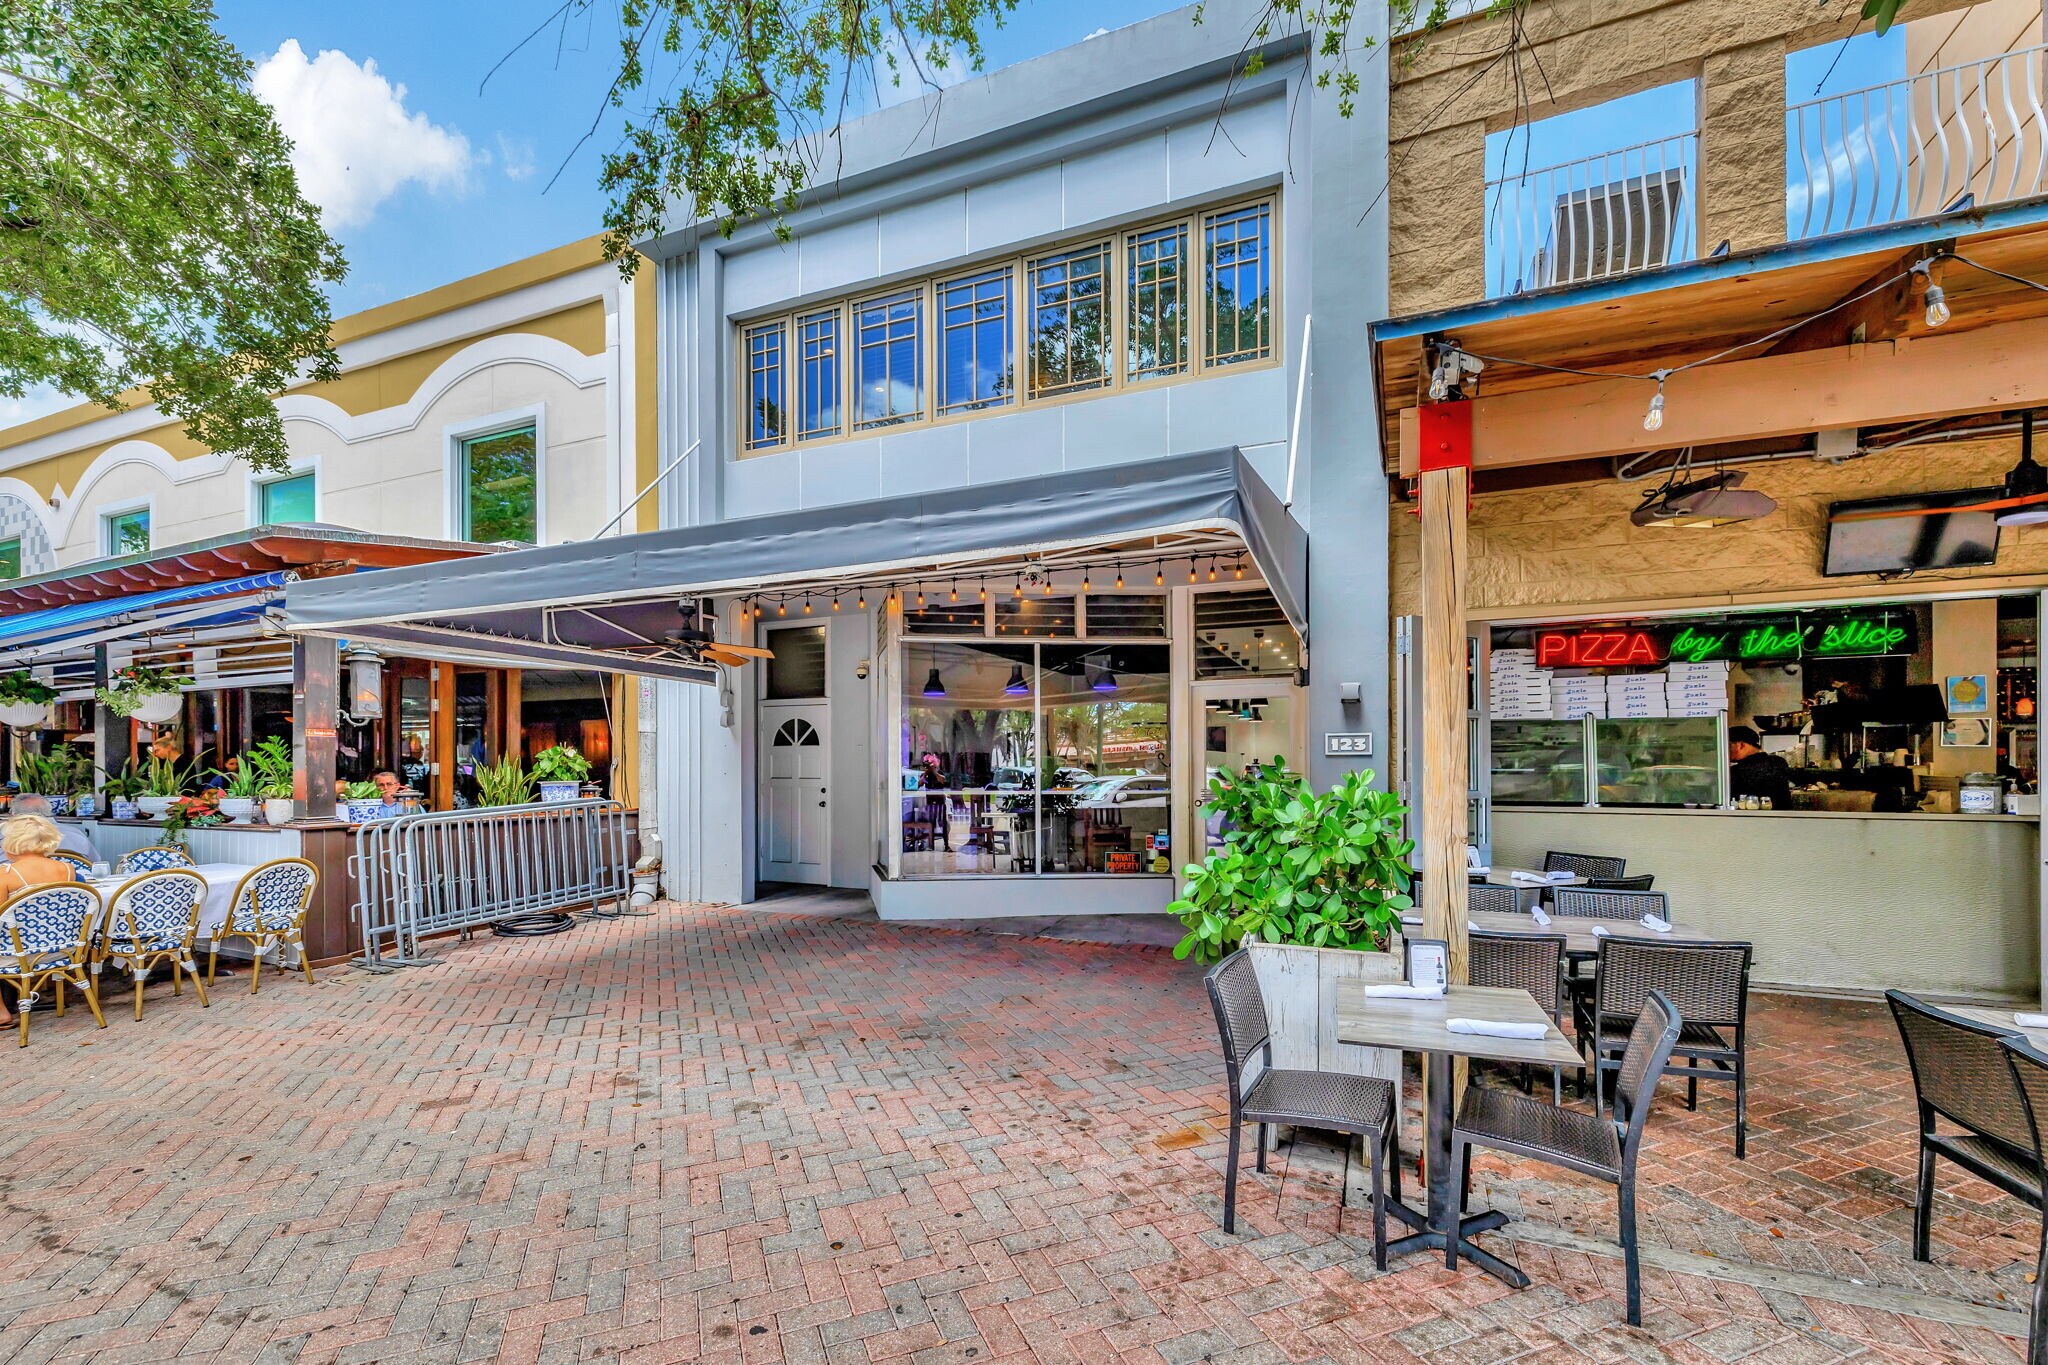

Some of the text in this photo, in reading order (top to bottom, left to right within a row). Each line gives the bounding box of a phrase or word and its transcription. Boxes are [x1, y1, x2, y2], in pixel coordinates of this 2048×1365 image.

[1540, 620, 1907, 664] PIZZA by the slice
[1331, 738, 1366, 751] 123
[1110, 853, 1136, 862] PRIVATE
[1107, 861, 1140, 870] PROPERTY
